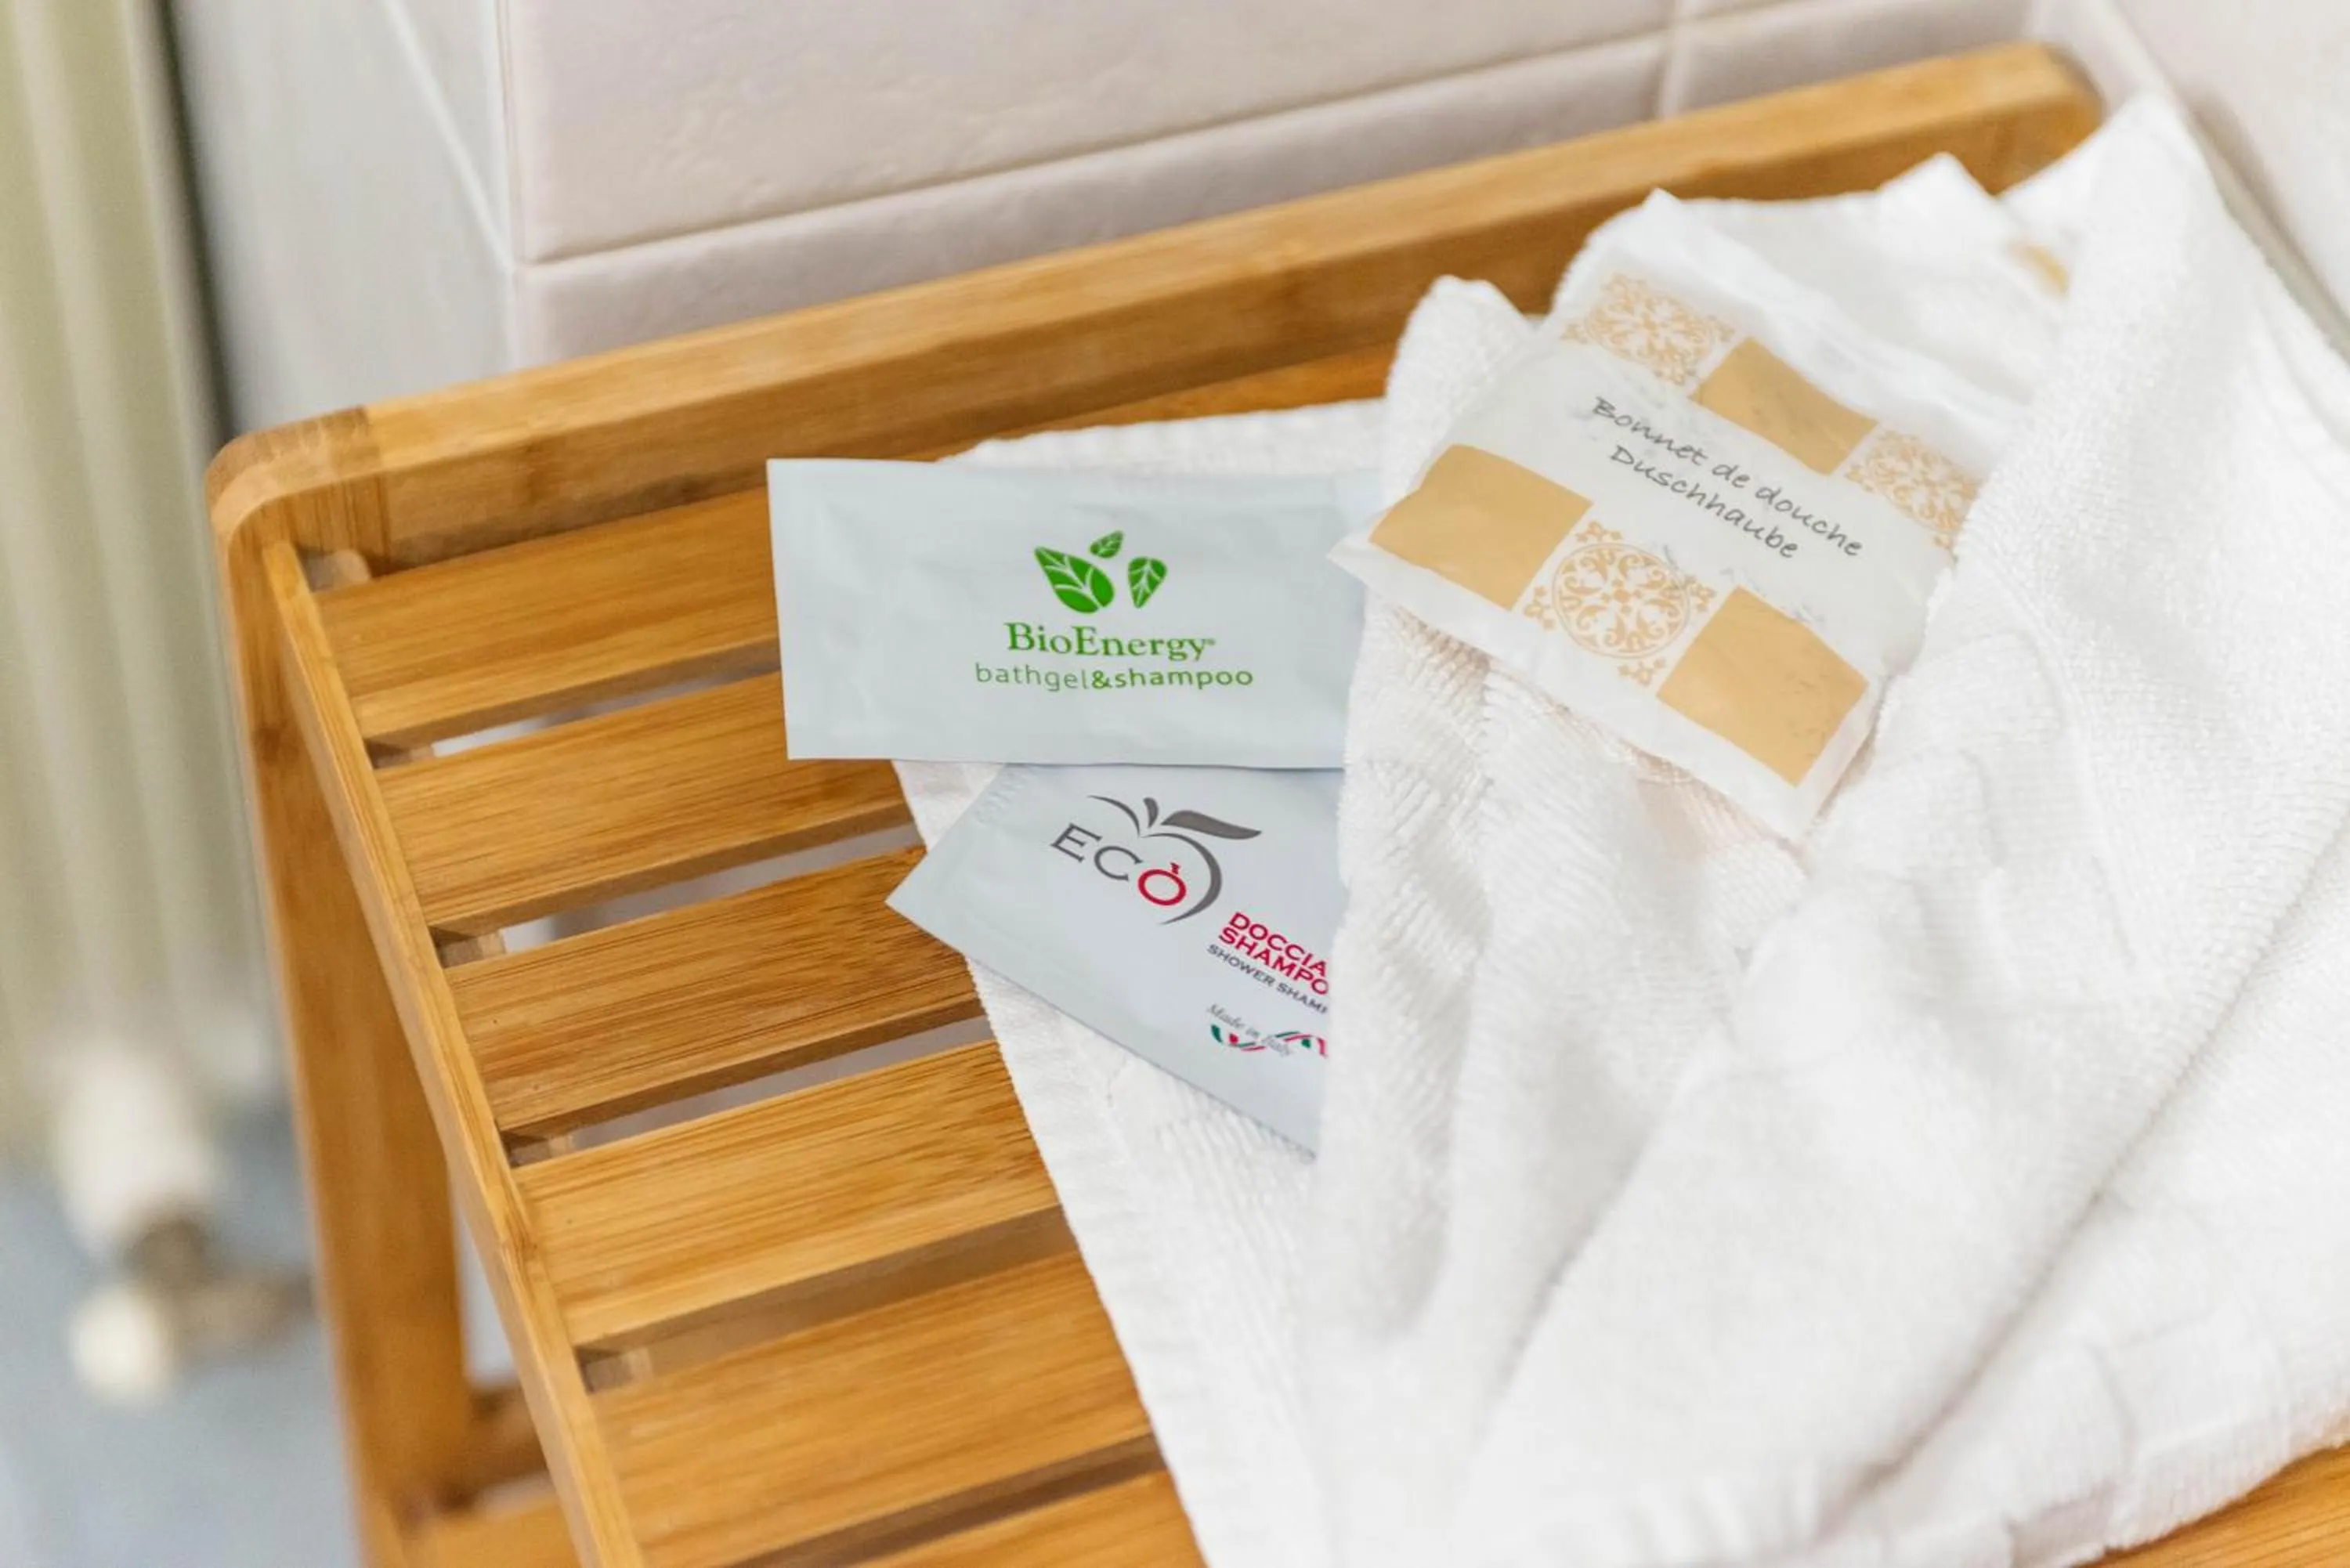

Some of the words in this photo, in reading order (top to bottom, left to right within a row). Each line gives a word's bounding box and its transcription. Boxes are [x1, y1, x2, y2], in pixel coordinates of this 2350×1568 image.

[1593, 396, 1708, 466] Bonnet
[1712, 464, 1750, 488] de
[1755, 486, 1863, 556] douche
[1610, 445, 1799, 558] Duschhaube
[976, 663, 1253, 691] bathgel&shampoo
[1207, 944, 1275, 986] SHOWER
[1228, 912, 1326, 977] DOCCIA
[1207, 1004, 1245, 1028] Made
